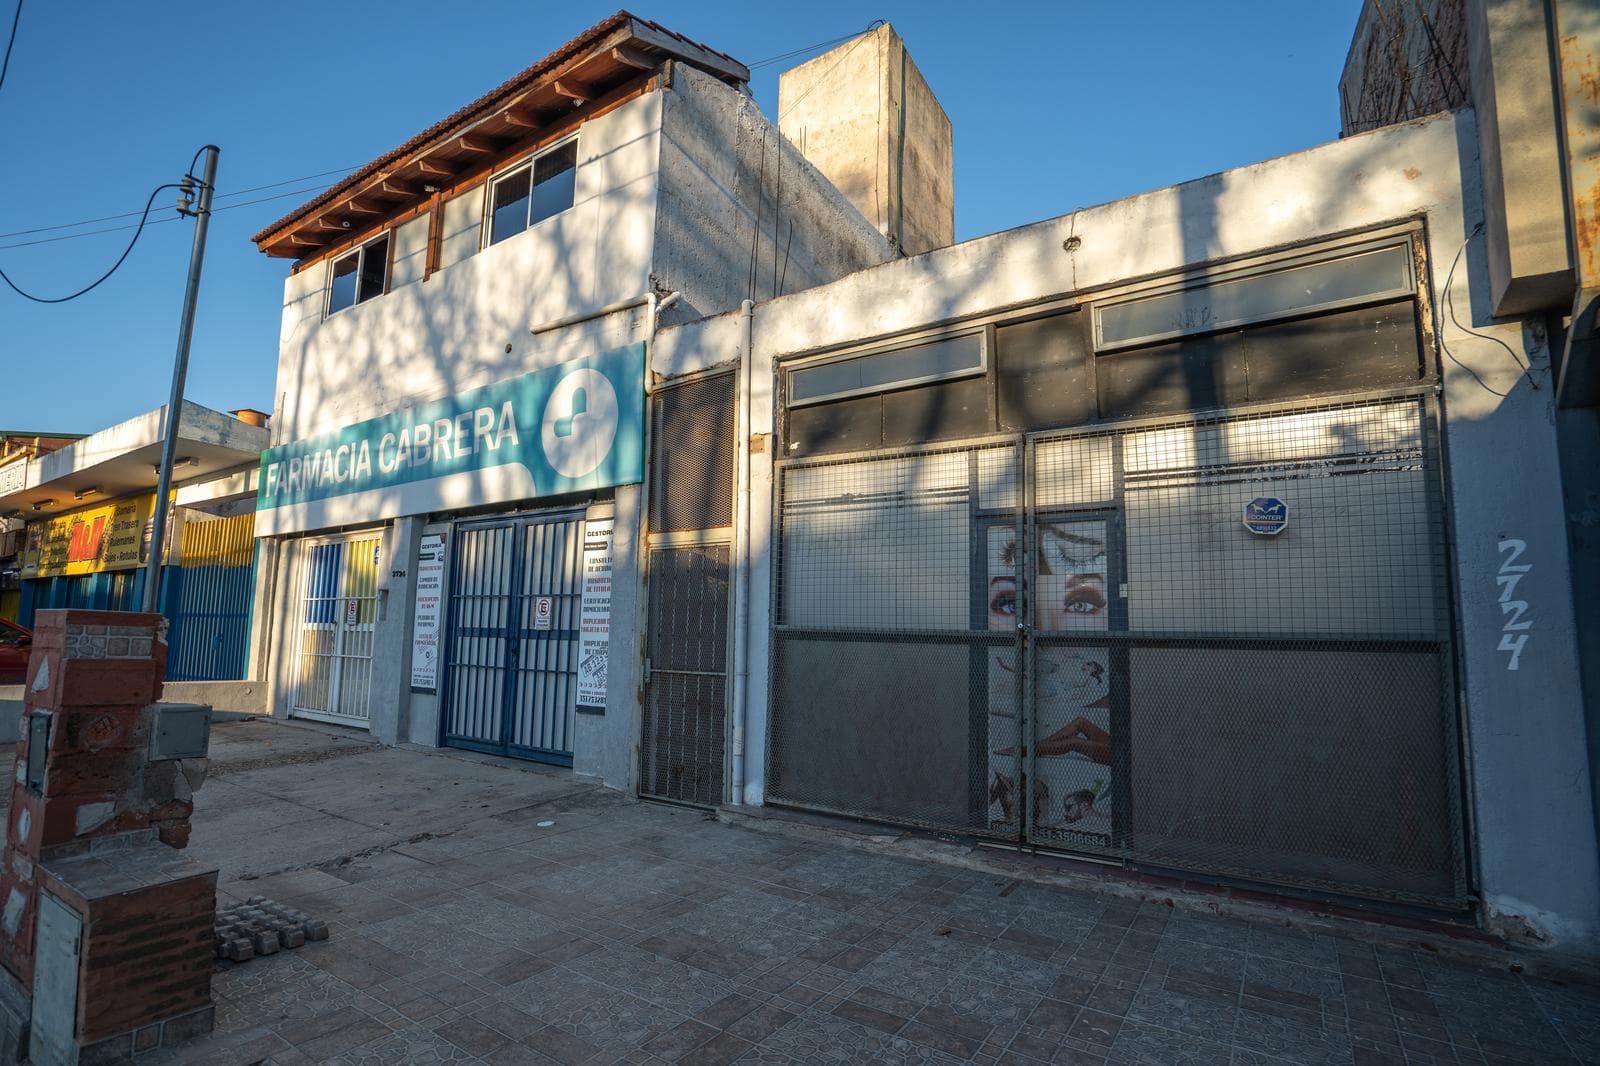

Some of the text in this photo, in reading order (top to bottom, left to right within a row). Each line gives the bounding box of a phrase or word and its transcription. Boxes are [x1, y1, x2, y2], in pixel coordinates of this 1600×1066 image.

[265, 401, 519, 498] FARMACIA CABRERA
[1496, 538, 1533, 671] 2724
